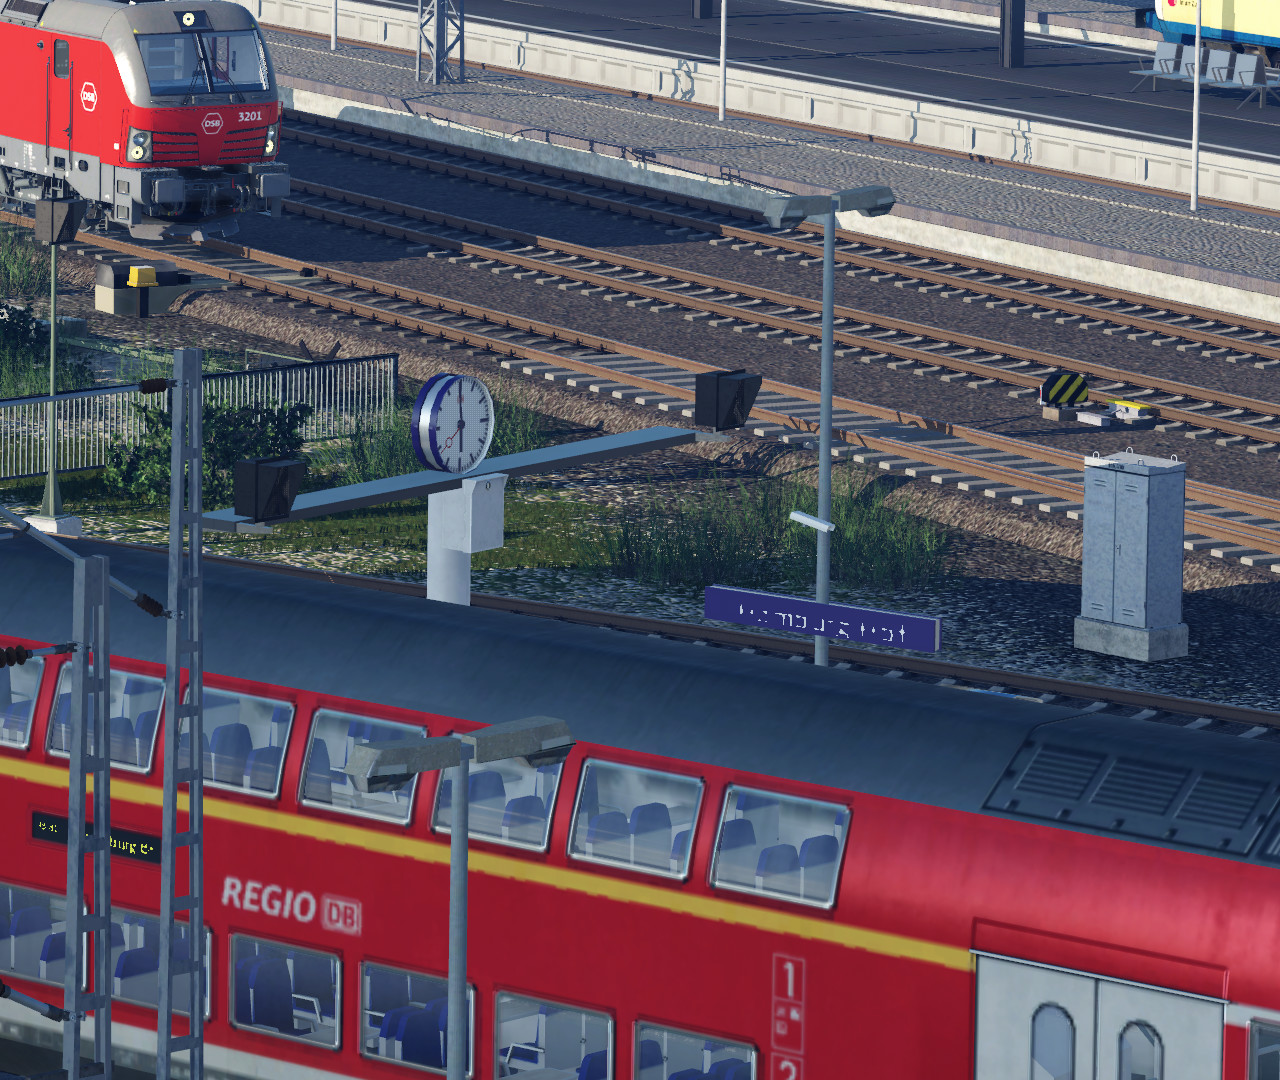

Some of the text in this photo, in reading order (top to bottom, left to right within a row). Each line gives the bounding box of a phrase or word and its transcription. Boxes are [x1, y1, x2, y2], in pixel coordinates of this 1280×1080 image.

[238, 111, 262, 122] 3201
[221, 876, 361, 936] REGIO DB
[783, 961, 794, 998] 1
